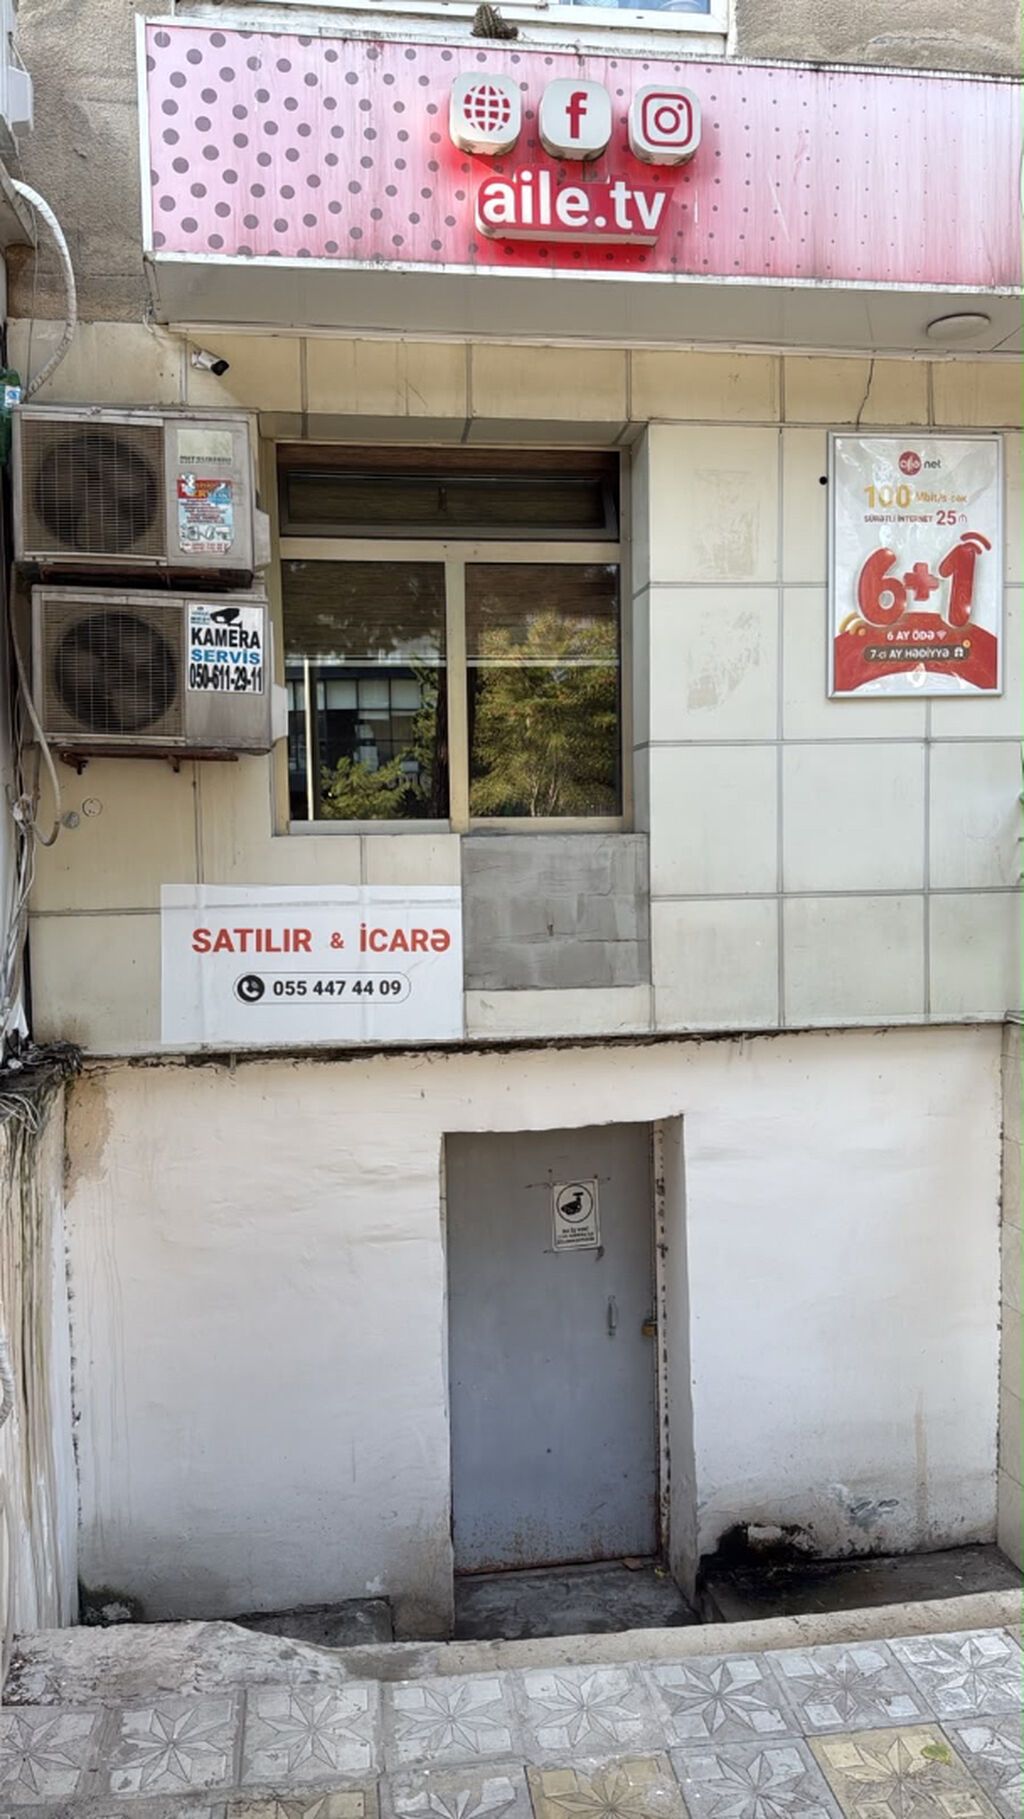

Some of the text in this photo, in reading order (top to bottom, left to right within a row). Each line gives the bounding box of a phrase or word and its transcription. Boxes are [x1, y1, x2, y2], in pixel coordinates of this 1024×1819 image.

[483, 170, 666, 230] aile.tv
[923, 459, 942, 469] net
[864, 484, 911, 509] 100
[858, 542, 977, 628] 6+1
[191, 626, 261, 649] KAMERA
[886, 631, 894, 641] 6
[896, 630, 910, 640] AY
[191, 647, 261, 665] SERVİS
[889, 648, 903, 659] AY
[189, 662, 263, 692] 050-611-29-11
[192, 922, 452, 953] SATILIR & İCARƏ
[273, 979, 402, 996] 055 447 44 09
